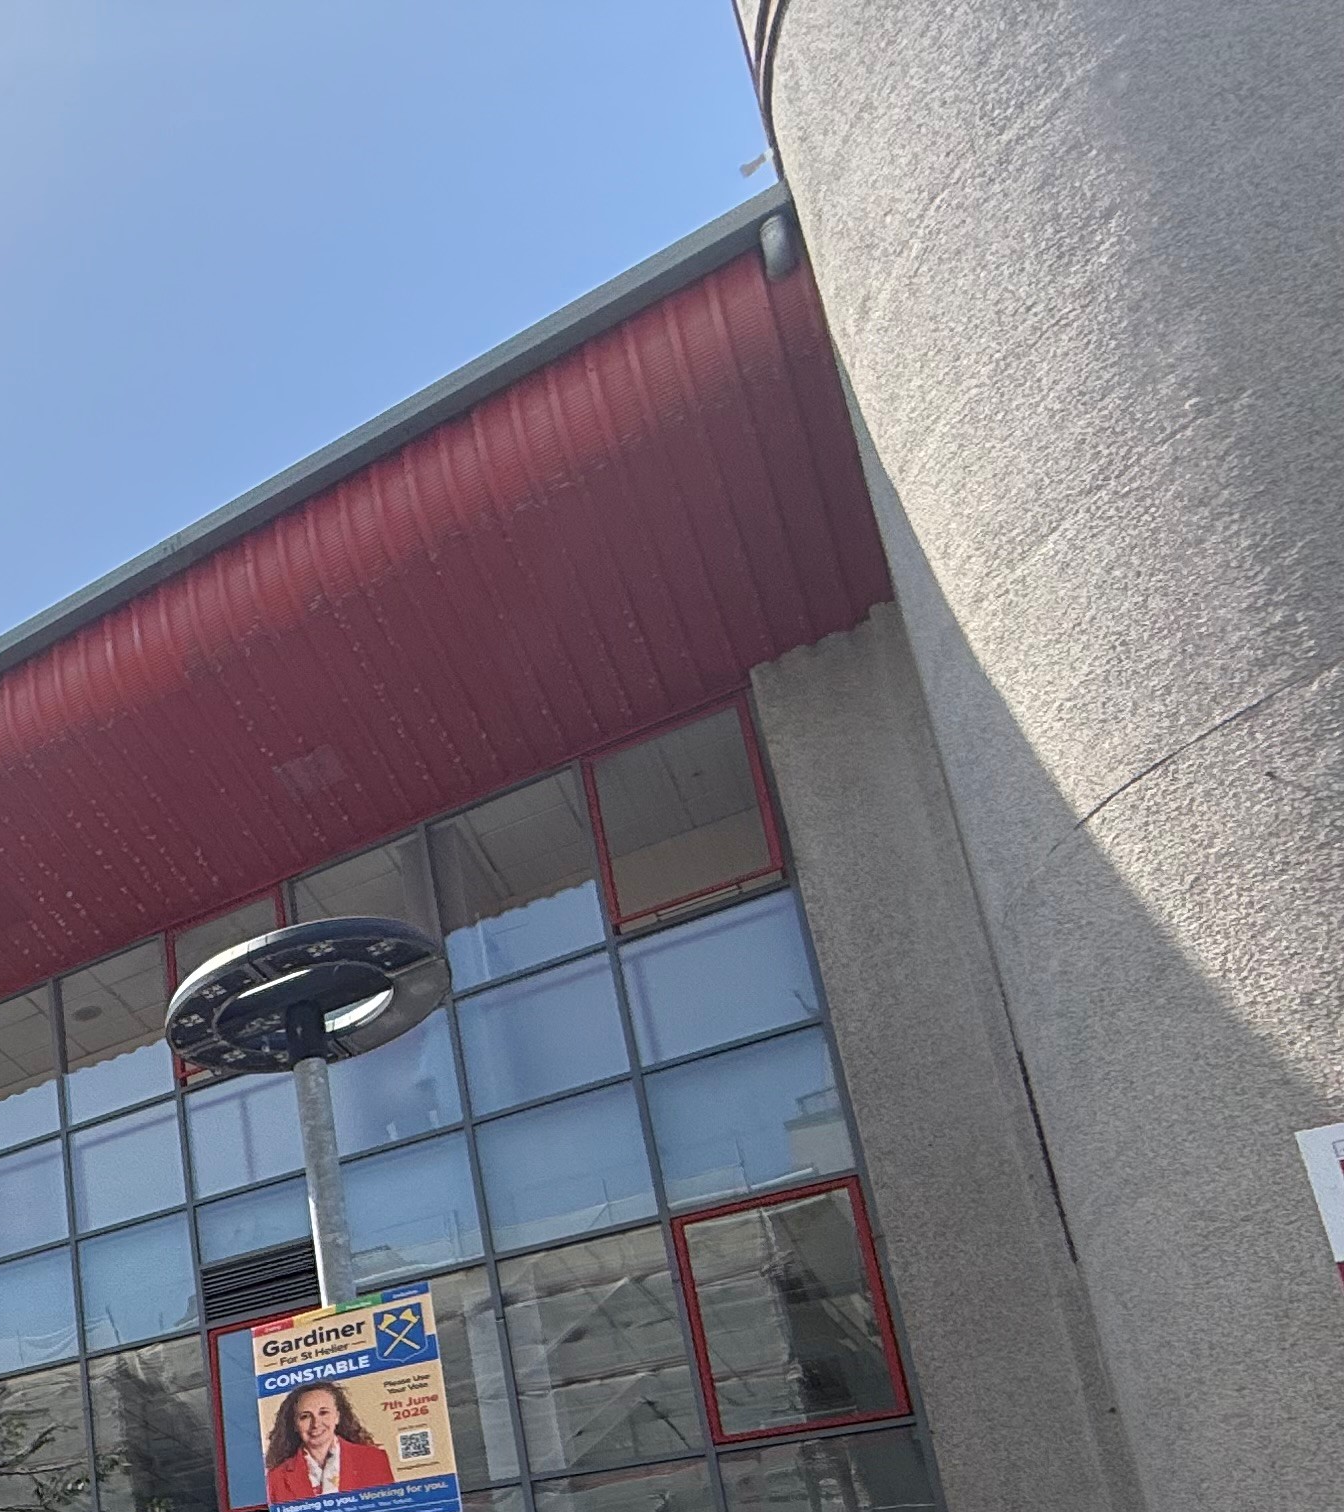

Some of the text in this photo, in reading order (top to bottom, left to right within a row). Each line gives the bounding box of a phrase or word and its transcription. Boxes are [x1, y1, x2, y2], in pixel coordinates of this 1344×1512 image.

[263, 1320, 367, 1357] Gardiner
[280, 1343, 351, 1367] For St Helier
[265, 1355, 371, 1390] CONSTABLE
[384, 1378, 411, 1387] Please
[381, 1394, 439, 1411] 7th June
[393, 1405, 429, 1421] 2026
[323, 1499, 335, 1507] to
[359, 1485, 405, 1501] Working
[406, 1484, 423, 1493] for
